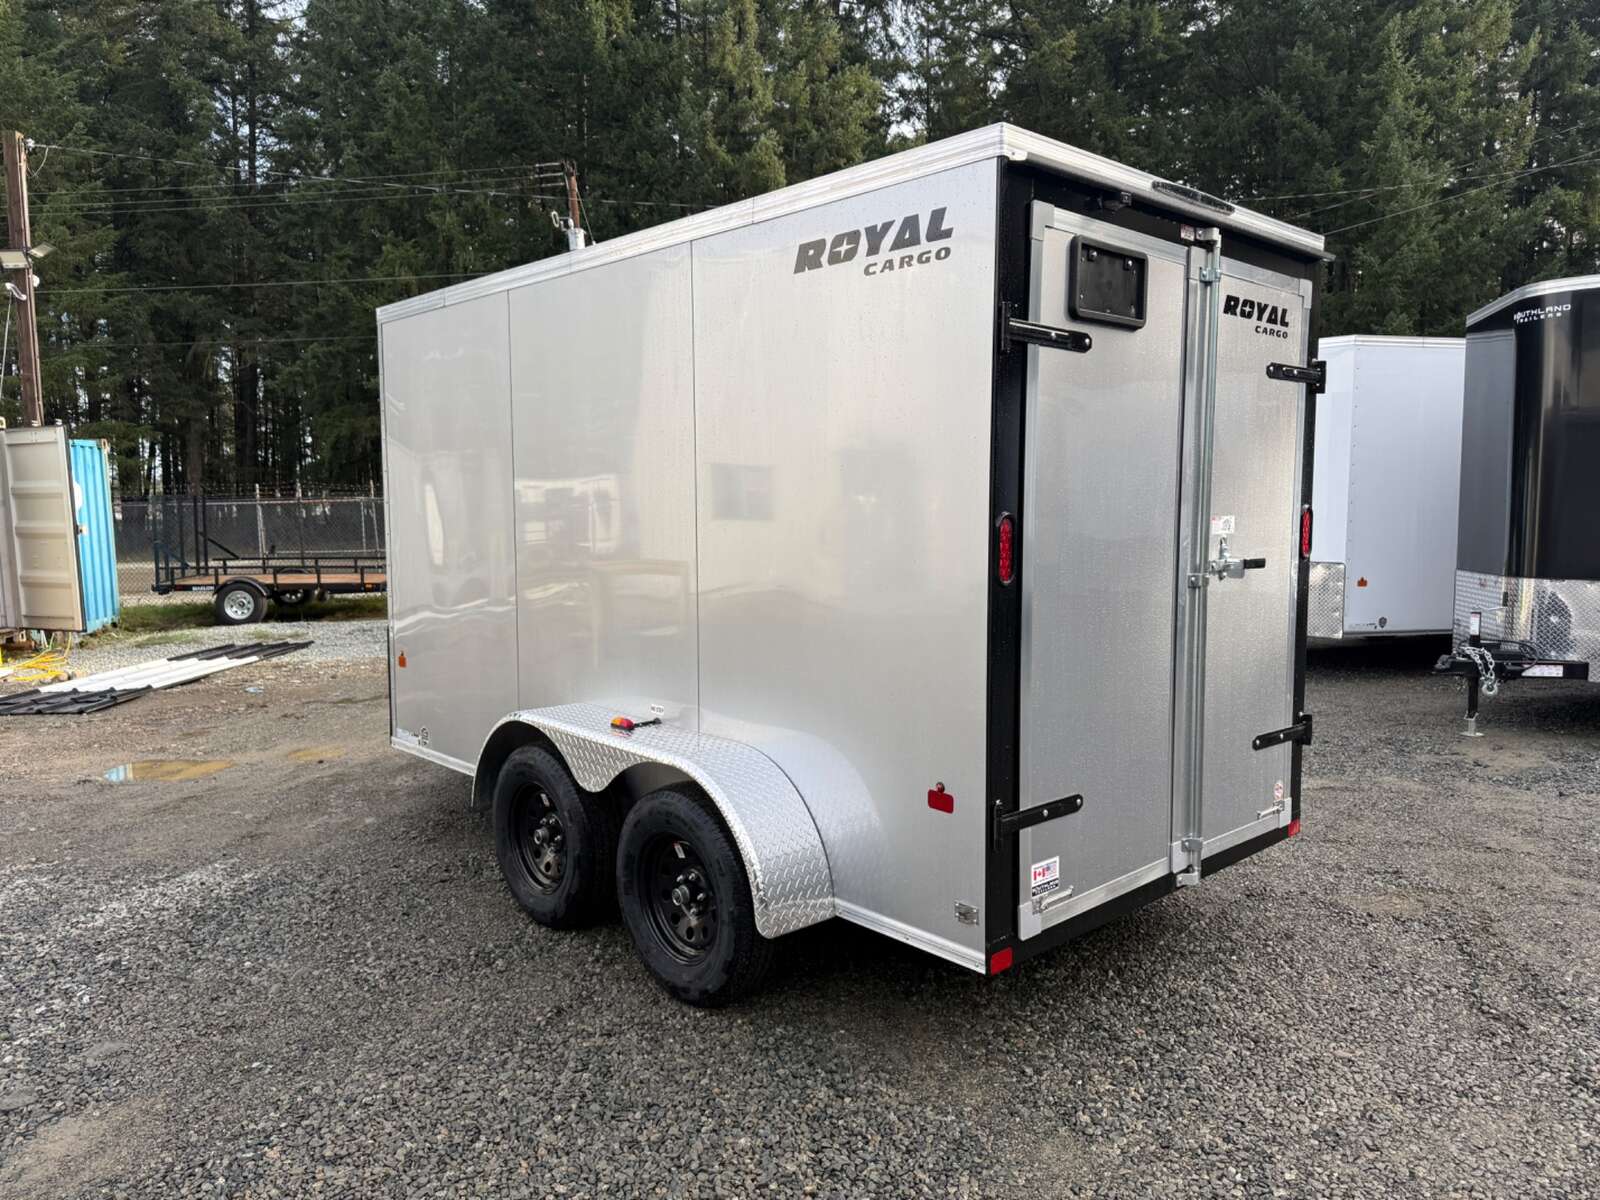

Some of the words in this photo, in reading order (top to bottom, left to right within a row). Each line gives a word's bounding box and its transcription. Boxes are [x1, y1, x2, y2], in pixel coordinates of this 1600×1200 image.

[793, 207, 954, 274] ROYAL
[863, 247, 951, 276] CARGO
[1223, 294, 1289, 327] ROYAL
[1255, 325, 1288, 339] CARGO
